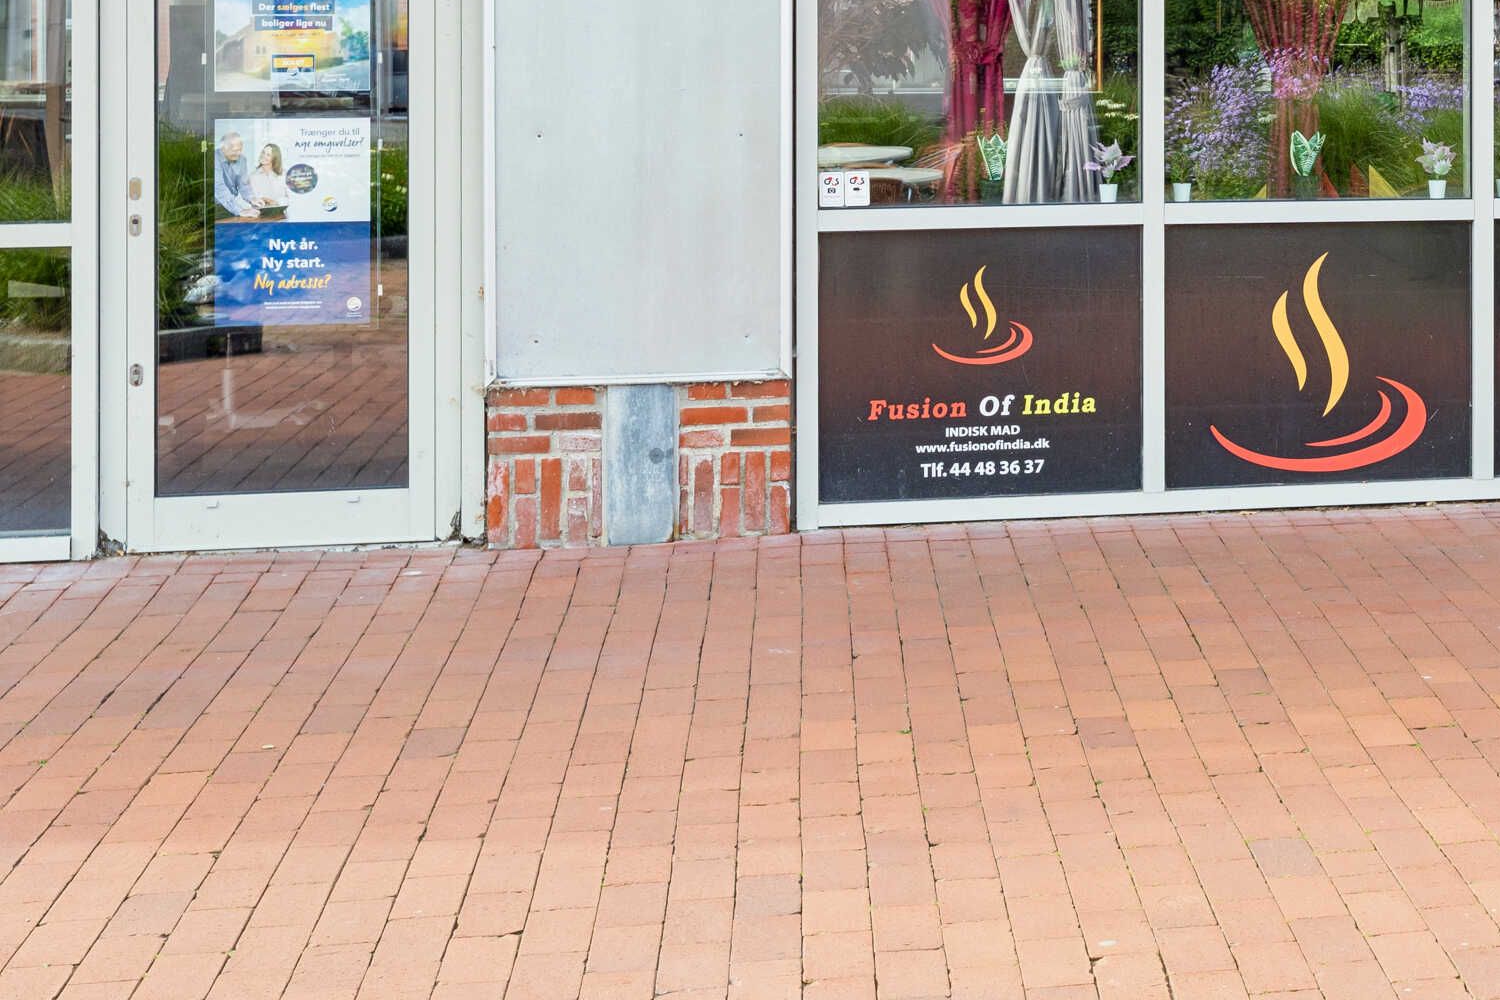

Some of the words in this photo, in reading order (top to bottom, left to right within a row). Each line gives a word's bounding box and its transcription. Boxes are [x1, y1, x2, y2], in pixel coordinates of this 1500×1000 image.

[338, 128, 350, 136] du
[269, 238, 297, 254] Nyt
[299, 237, 319, 250] år.
[262, 256, 283, 272] Ny
[287, 257, 325, 269] start.
[254, 273, 275, 296] Ny
[278, 274, 332, 289] adresse?
[867, 397, 967, 421] Fusion
[979, 394, 1015, 417] Of
[1022, 392, 1097, 415] India
[945, 426, 988, 438] INDISK
[990, 425, 1020, 436] MAD
[915, 438, 1050, 453] www.fusionofindia.dk
[920, 462, 948, 478] Tlf.
[949, 462, 971, 477] 44
[974, 461, 996, 476] 48
[999, 460, 1021, 475] 36
[1023, 459, 1045, 474] 37
